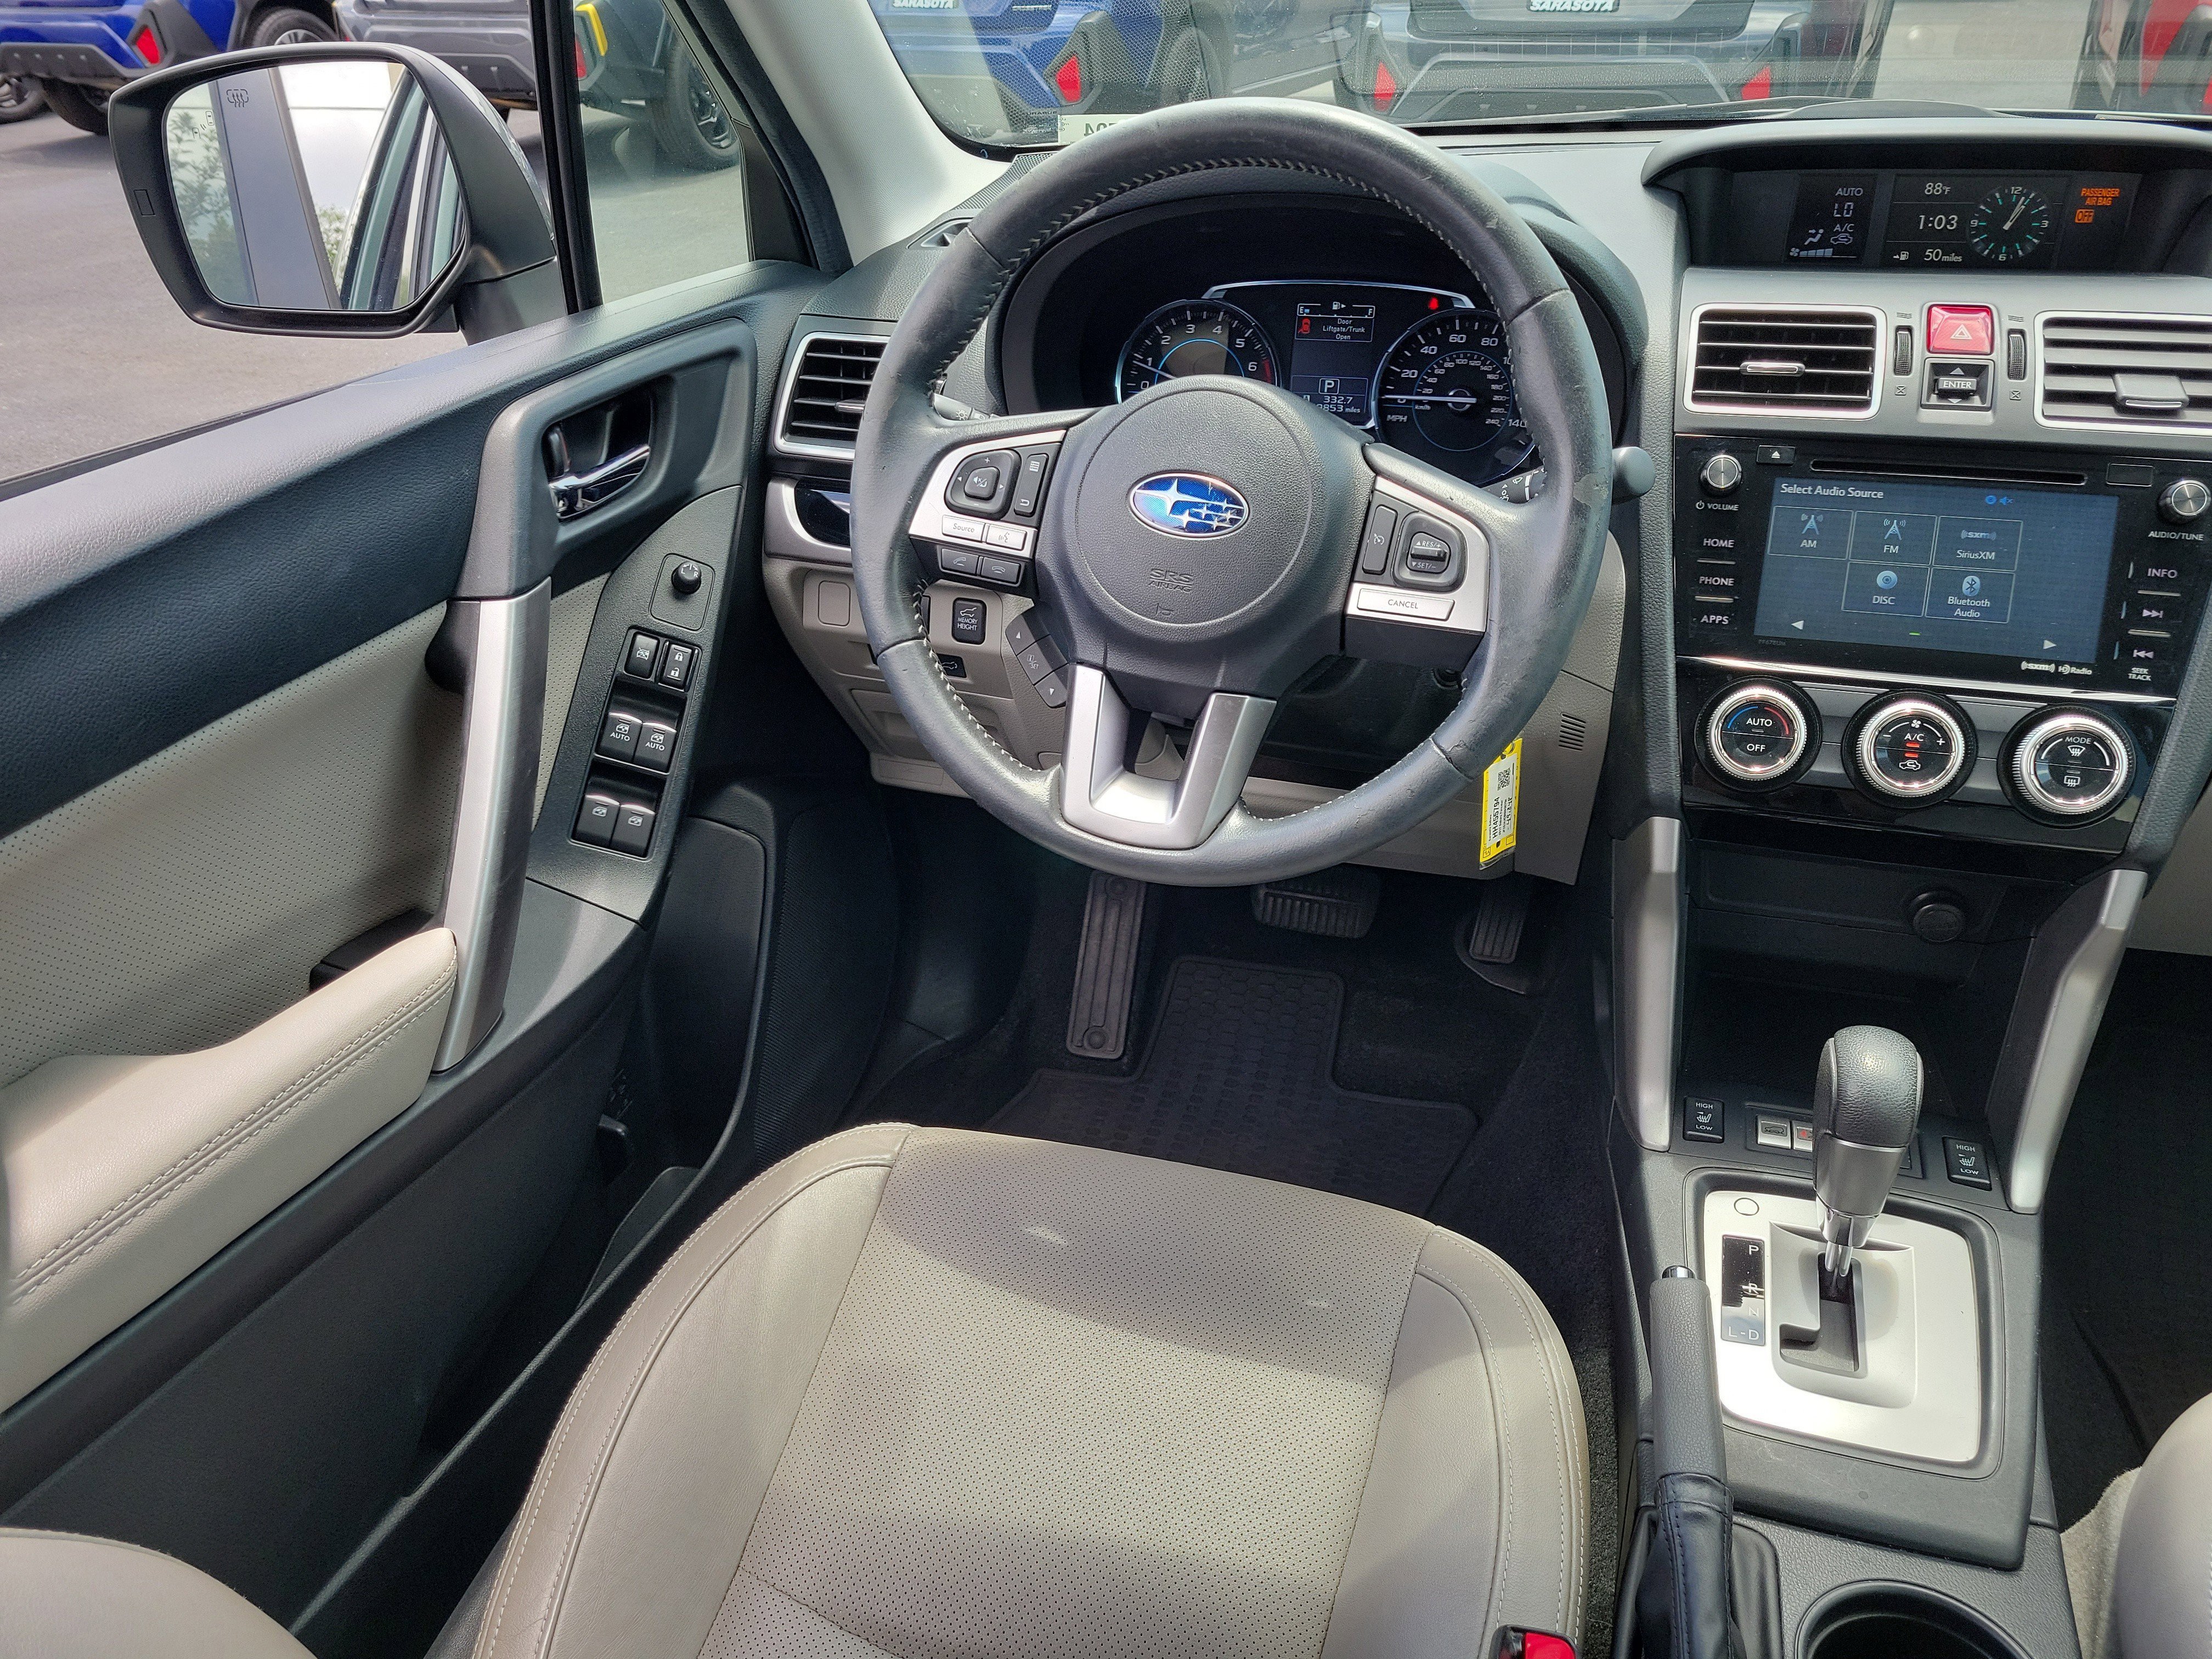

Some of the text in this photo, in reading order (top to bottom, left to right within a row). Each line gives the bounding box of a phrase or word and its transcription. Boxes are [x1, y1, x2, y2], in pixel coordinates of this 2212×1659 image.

[1530, 0, 1615, 12] SARASOTA
[1835, 188, 1864, 196] AUTO
[2080, 188, 2120, 198] PASSENGER
[1833, 202, 1854, 217] LO
[2077, 211, 2094, 221] OFF
[1919, 215, 1958, 230] 1:03
[1833, 223, 1854, 232] A/C
[1923, 249, 1962, 262] 50 miles
[1186, 325, 1195, 334] 3
[1212, 326, 1222, 335] 4
[1161, 336, 1171, 345] 2
[1235, 339, 1245, 347] 5
[1449, 335, 1466, 343] 60
[1481, 338, 1498, 346] 80
[1147, 358, 1153, 366] 1
[1249, 362, 1257, 371] 6
[1141, 381, 1149, 390] 0
[1324, 380, 1335, 392] P
[1943, 381, 1972, 389] ENTER
[1323, 396, 1353, 404] 332.7
[1780, 483, 1883, 499] Select Audio Source
[952, 523, 975, 533] Source
[2148, 530, 2204, 541] AUDIO/TUNE
[1703, 538, 1735, 548] HOME
[1800, 539, 1817, 548] AM
[1883, 545, 1899, 554] FM
[1956, 550, 1996, 560] SiriusXM
[1149, 568, 1194, 583] SRS
[2147, 568, 2177, 579] INFO
[1699, 576, 1735, 586] PHONE
[1148, 580, 1193, 593] AIRBAG
[1388, 599, 1418, 609] CANCEL
[1872, 595, 1895, 605] DISC
[1948, 596, 1990, 607] Bluetooth
[1954, 608, 1980, 618] Audio
[1701, 615, 1729, 624] APPS
[957, 623, 978, 631] HEIGHT
[2070, 667, 2092, 675] Radio
[1746, 718, 1773, 727] AUTO
[610, 732, 630, 742] AUTO
[1904, 733, 1924, 742] A/C
[2065, 736, 2092, 744] MODE
[645, 742, 665, 751] AUTO
[1747, 744, 1765, 752] OFF
[1696, 1102, 1713, 1110] HIGH
[1956, 1144, 1976, 1152] HIGH
[1960, 1167, 1979, 1176] LOW
[1748, 1244, 1759, 1255] P
